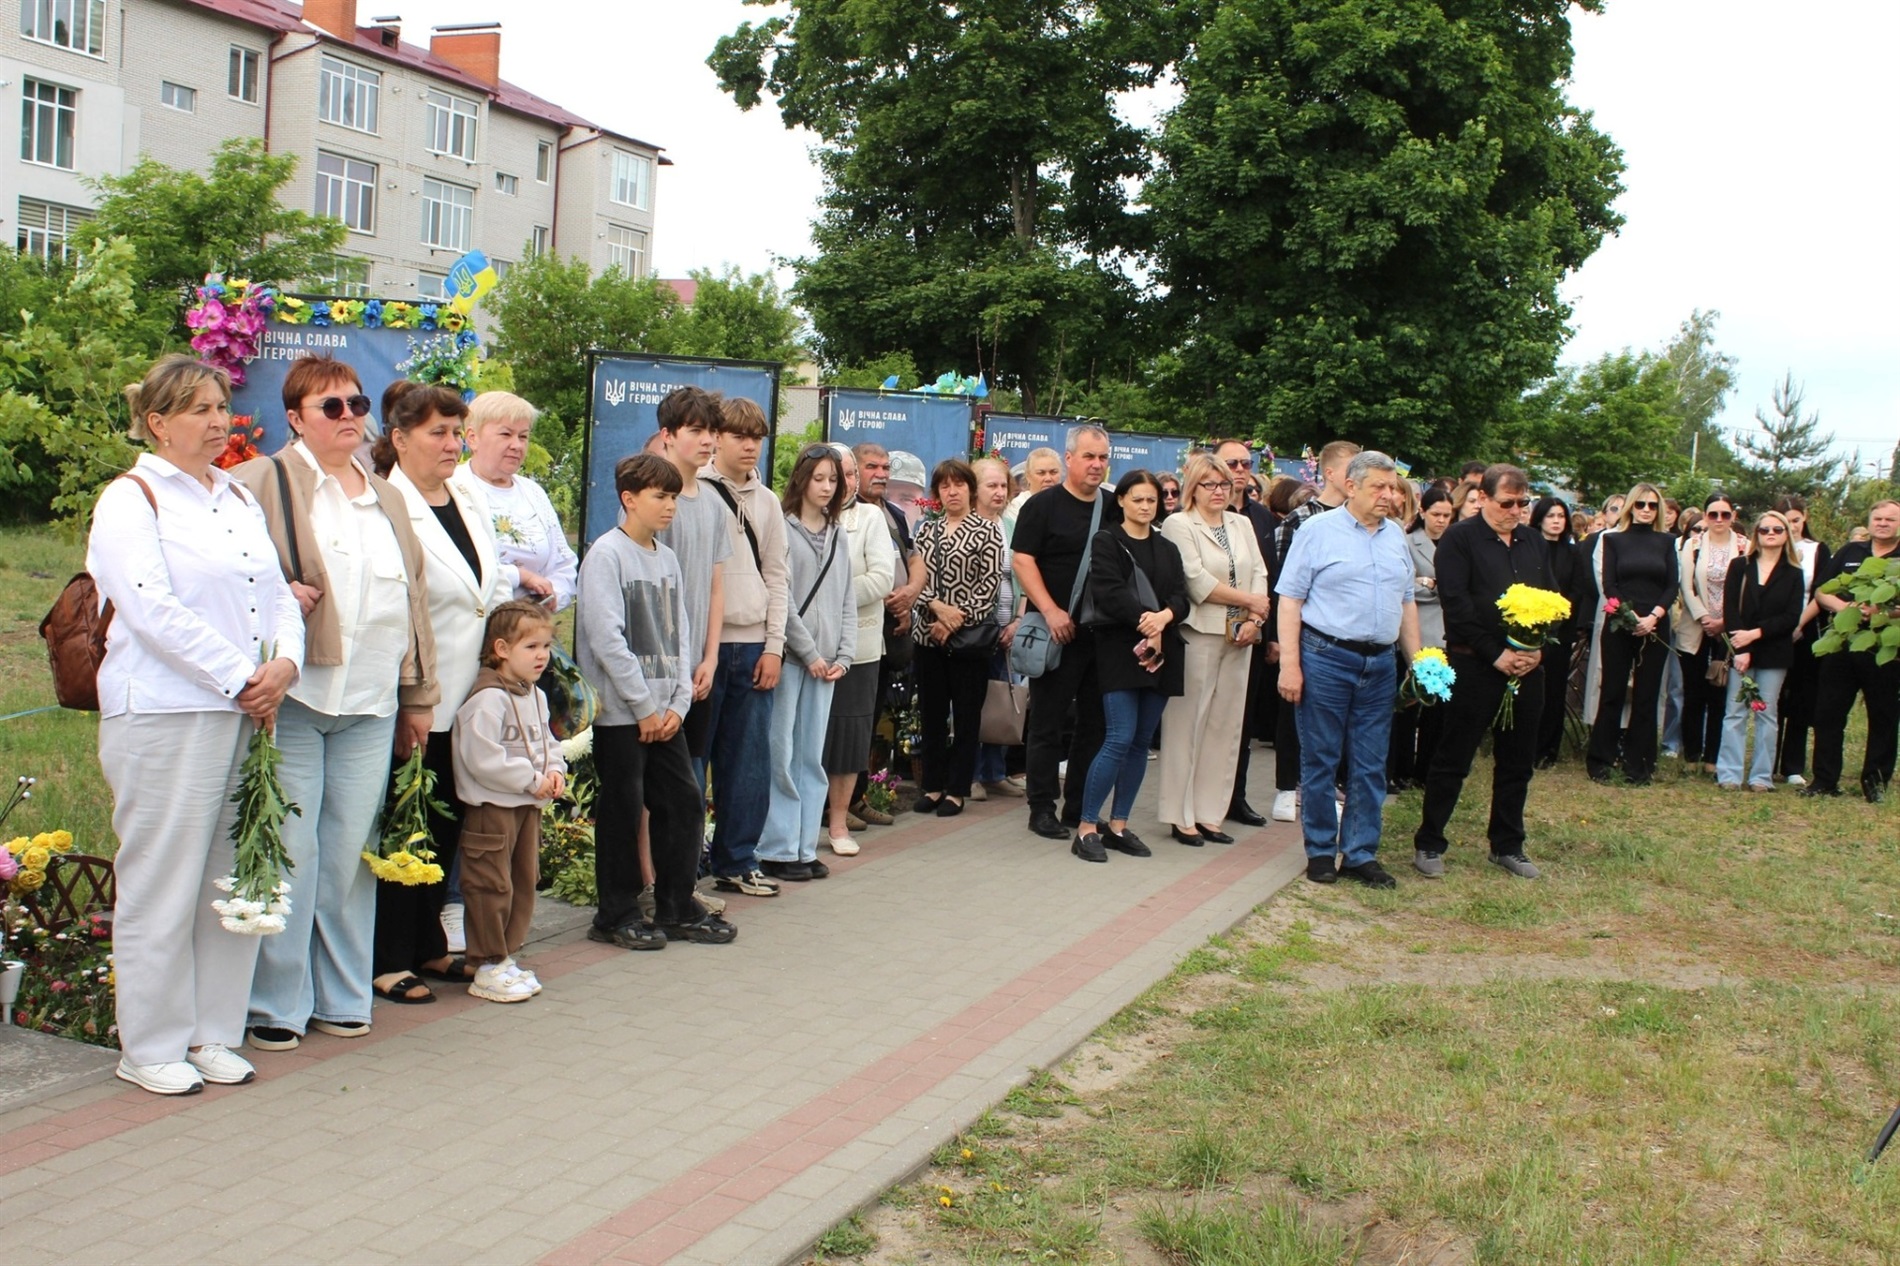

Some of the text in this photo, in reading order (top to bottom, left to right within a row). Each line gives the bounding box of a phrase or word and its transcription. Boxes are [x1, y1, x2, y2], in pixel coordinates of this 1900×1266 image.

[264, 331, 347, 348] ВІЧНА СЛАВА
[629, 381, 657, 393] ВІЧНА
[858, 410, 907, 422] ВІЧНА СЛАВА
[857, 420, 886, 430] ГЕРОЮ!
[1007, 432, 1049, 442] ВІЧНА СЛАВА
